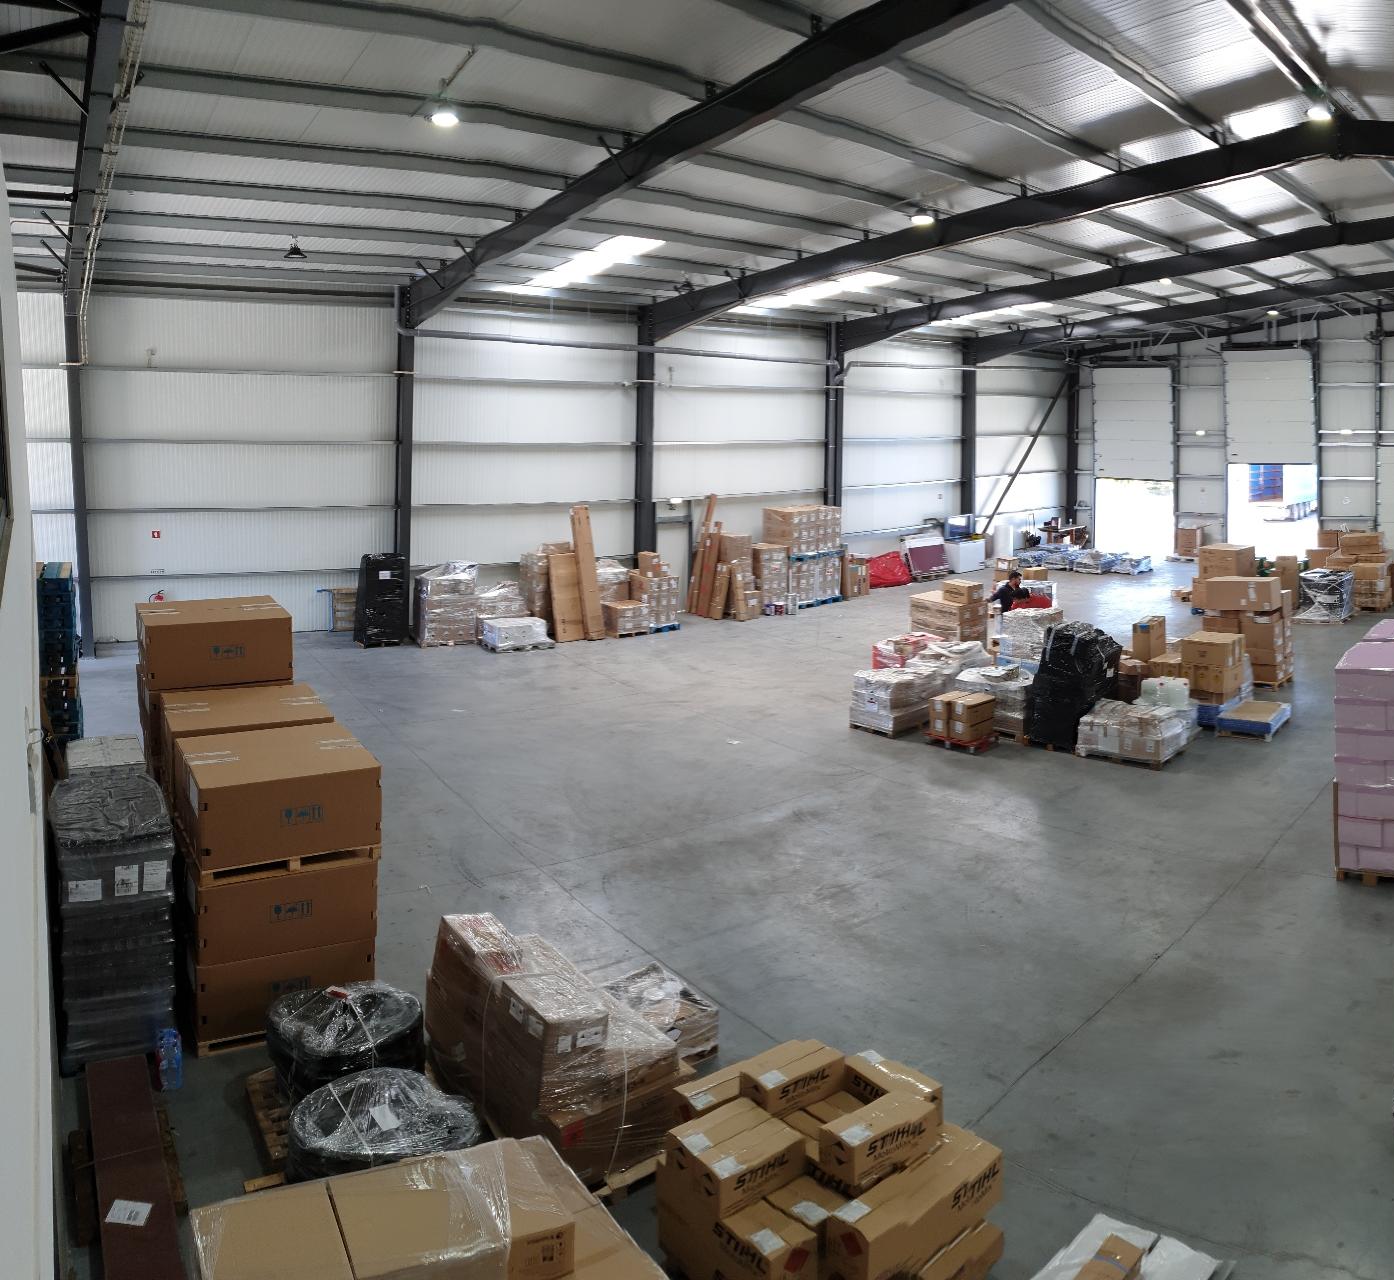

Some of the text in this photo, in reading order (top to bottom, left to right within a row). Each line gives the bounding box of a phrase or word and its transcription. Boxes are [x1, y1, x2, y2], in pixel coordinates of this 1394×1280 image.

[779, 1068, 830, 1100] STIHL
[866, 1121, 927, 1158] STIHL
[733, 1153, 789, 1191] STIHL
[712, 1221, 767, 1275] STIHL
